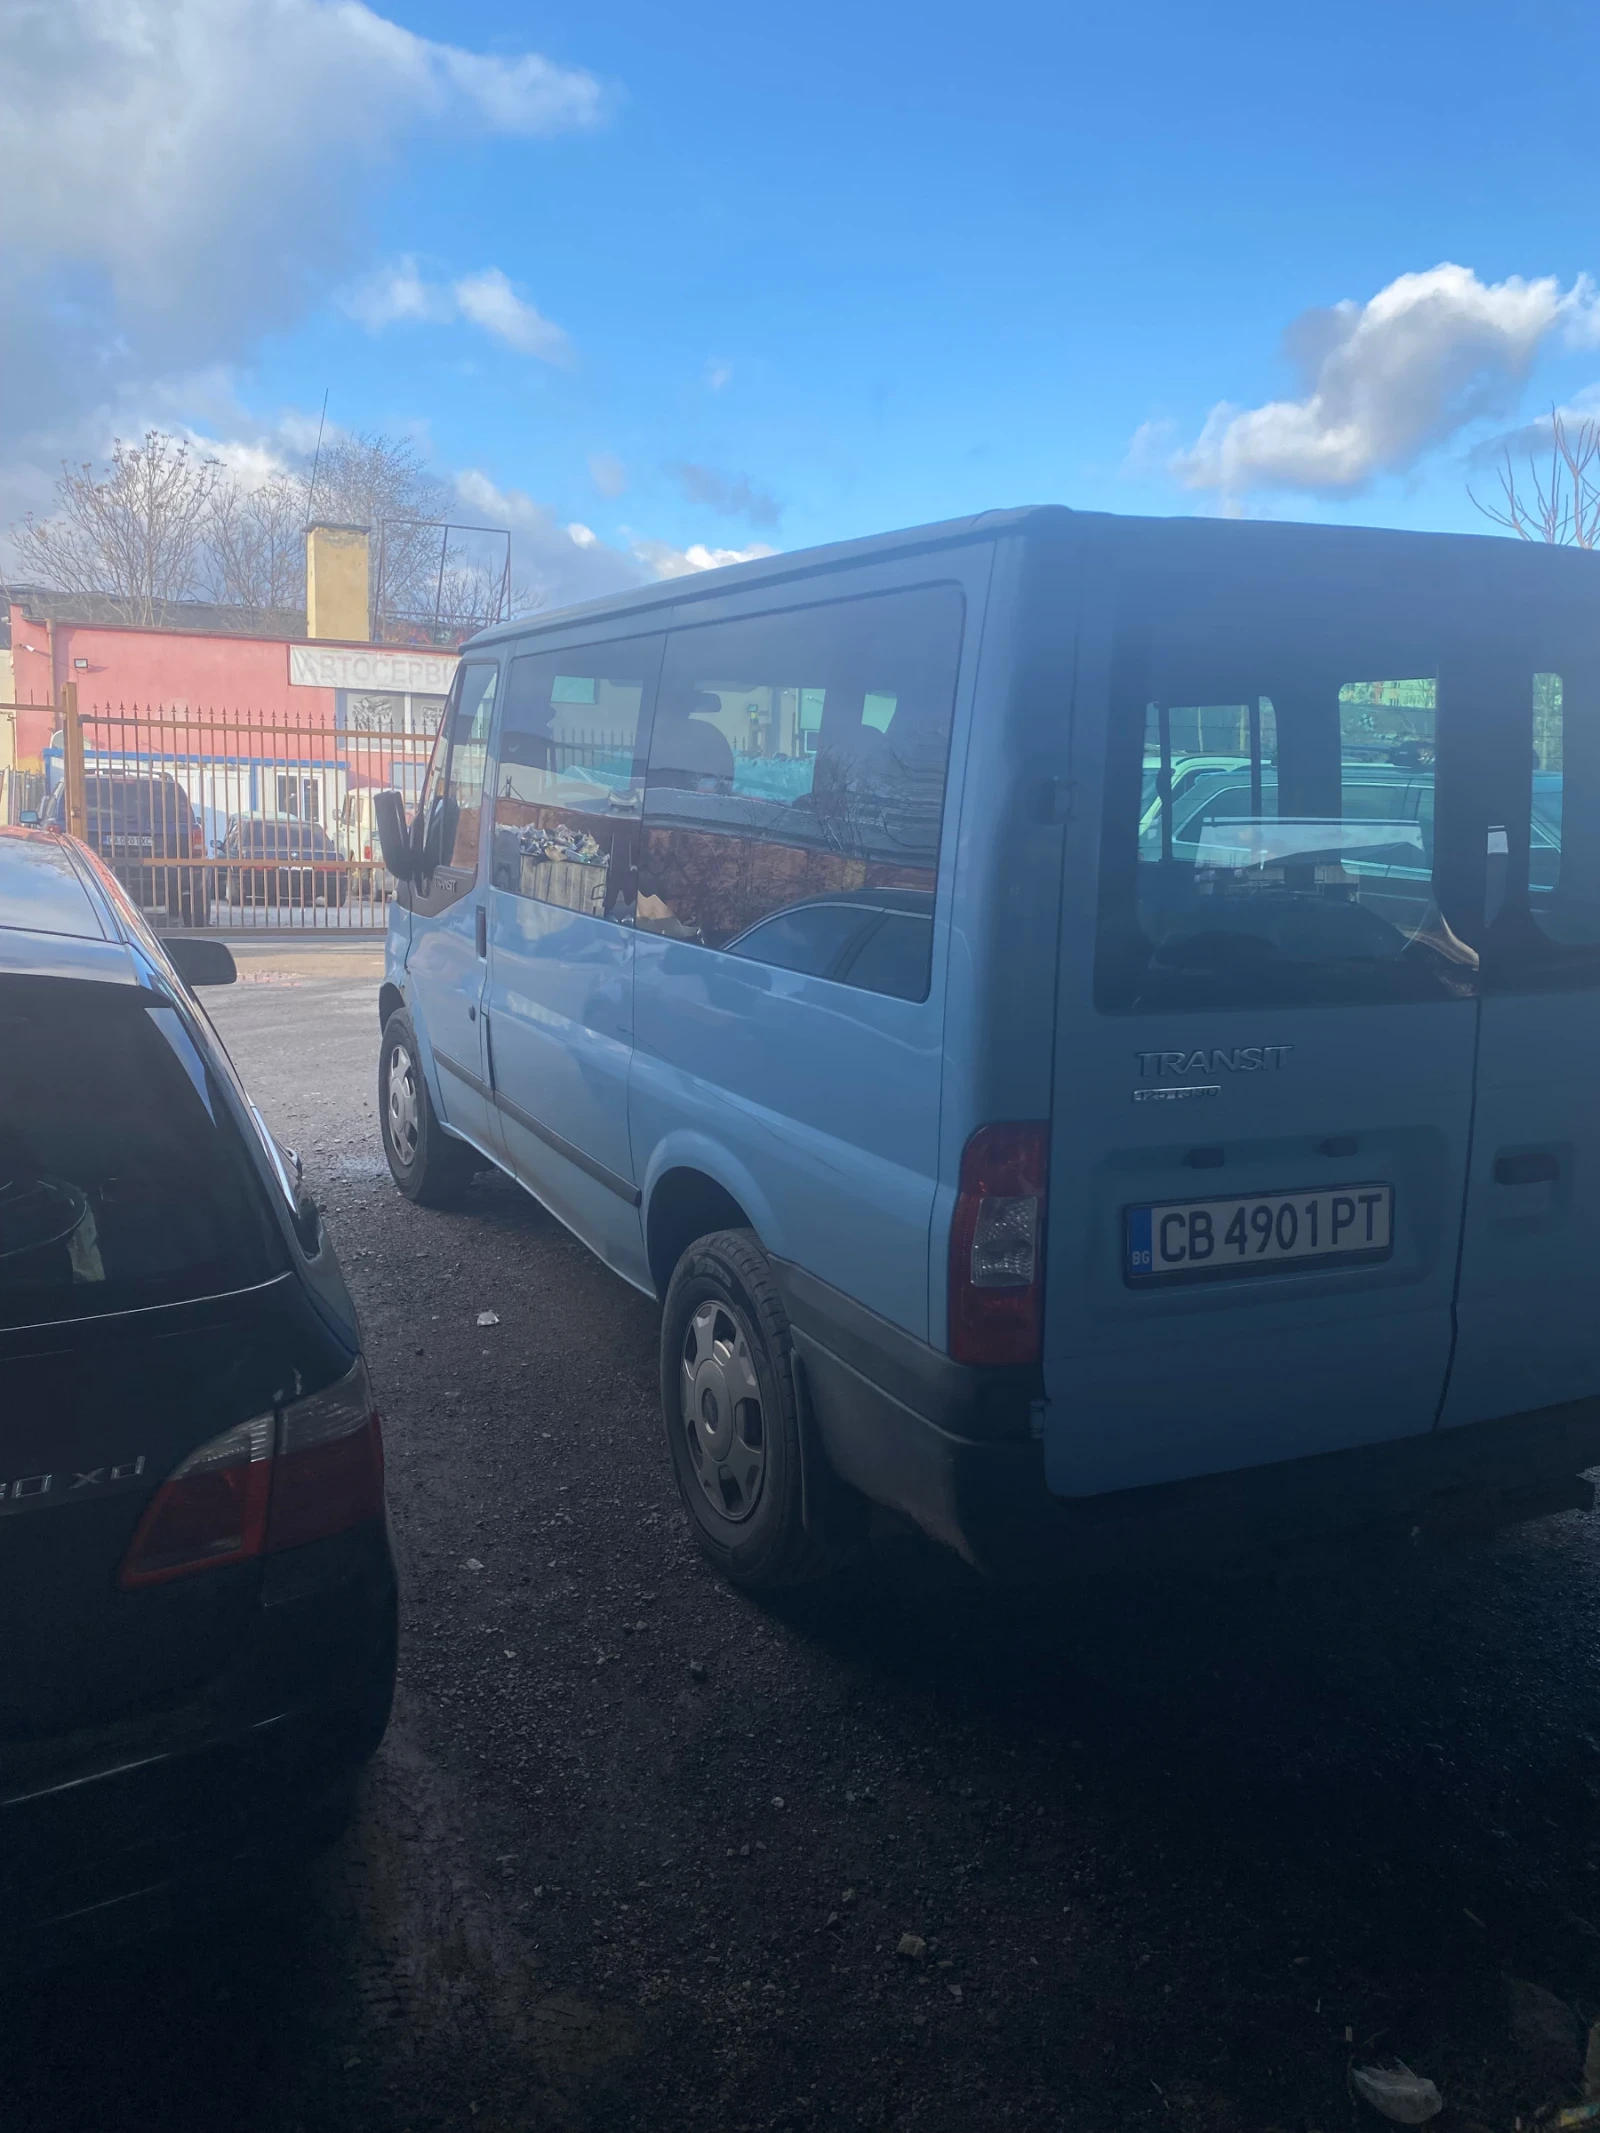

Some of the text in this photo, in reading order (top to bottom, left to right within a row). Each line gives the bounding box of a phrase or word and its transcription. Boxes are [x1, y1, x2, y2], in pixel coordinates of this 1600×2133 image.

[1136, 1045, 1293, 1077] TRANSIT
[1132, 1250, 1150, 1266] BG
[0, 1474, 52, 1499] 0
